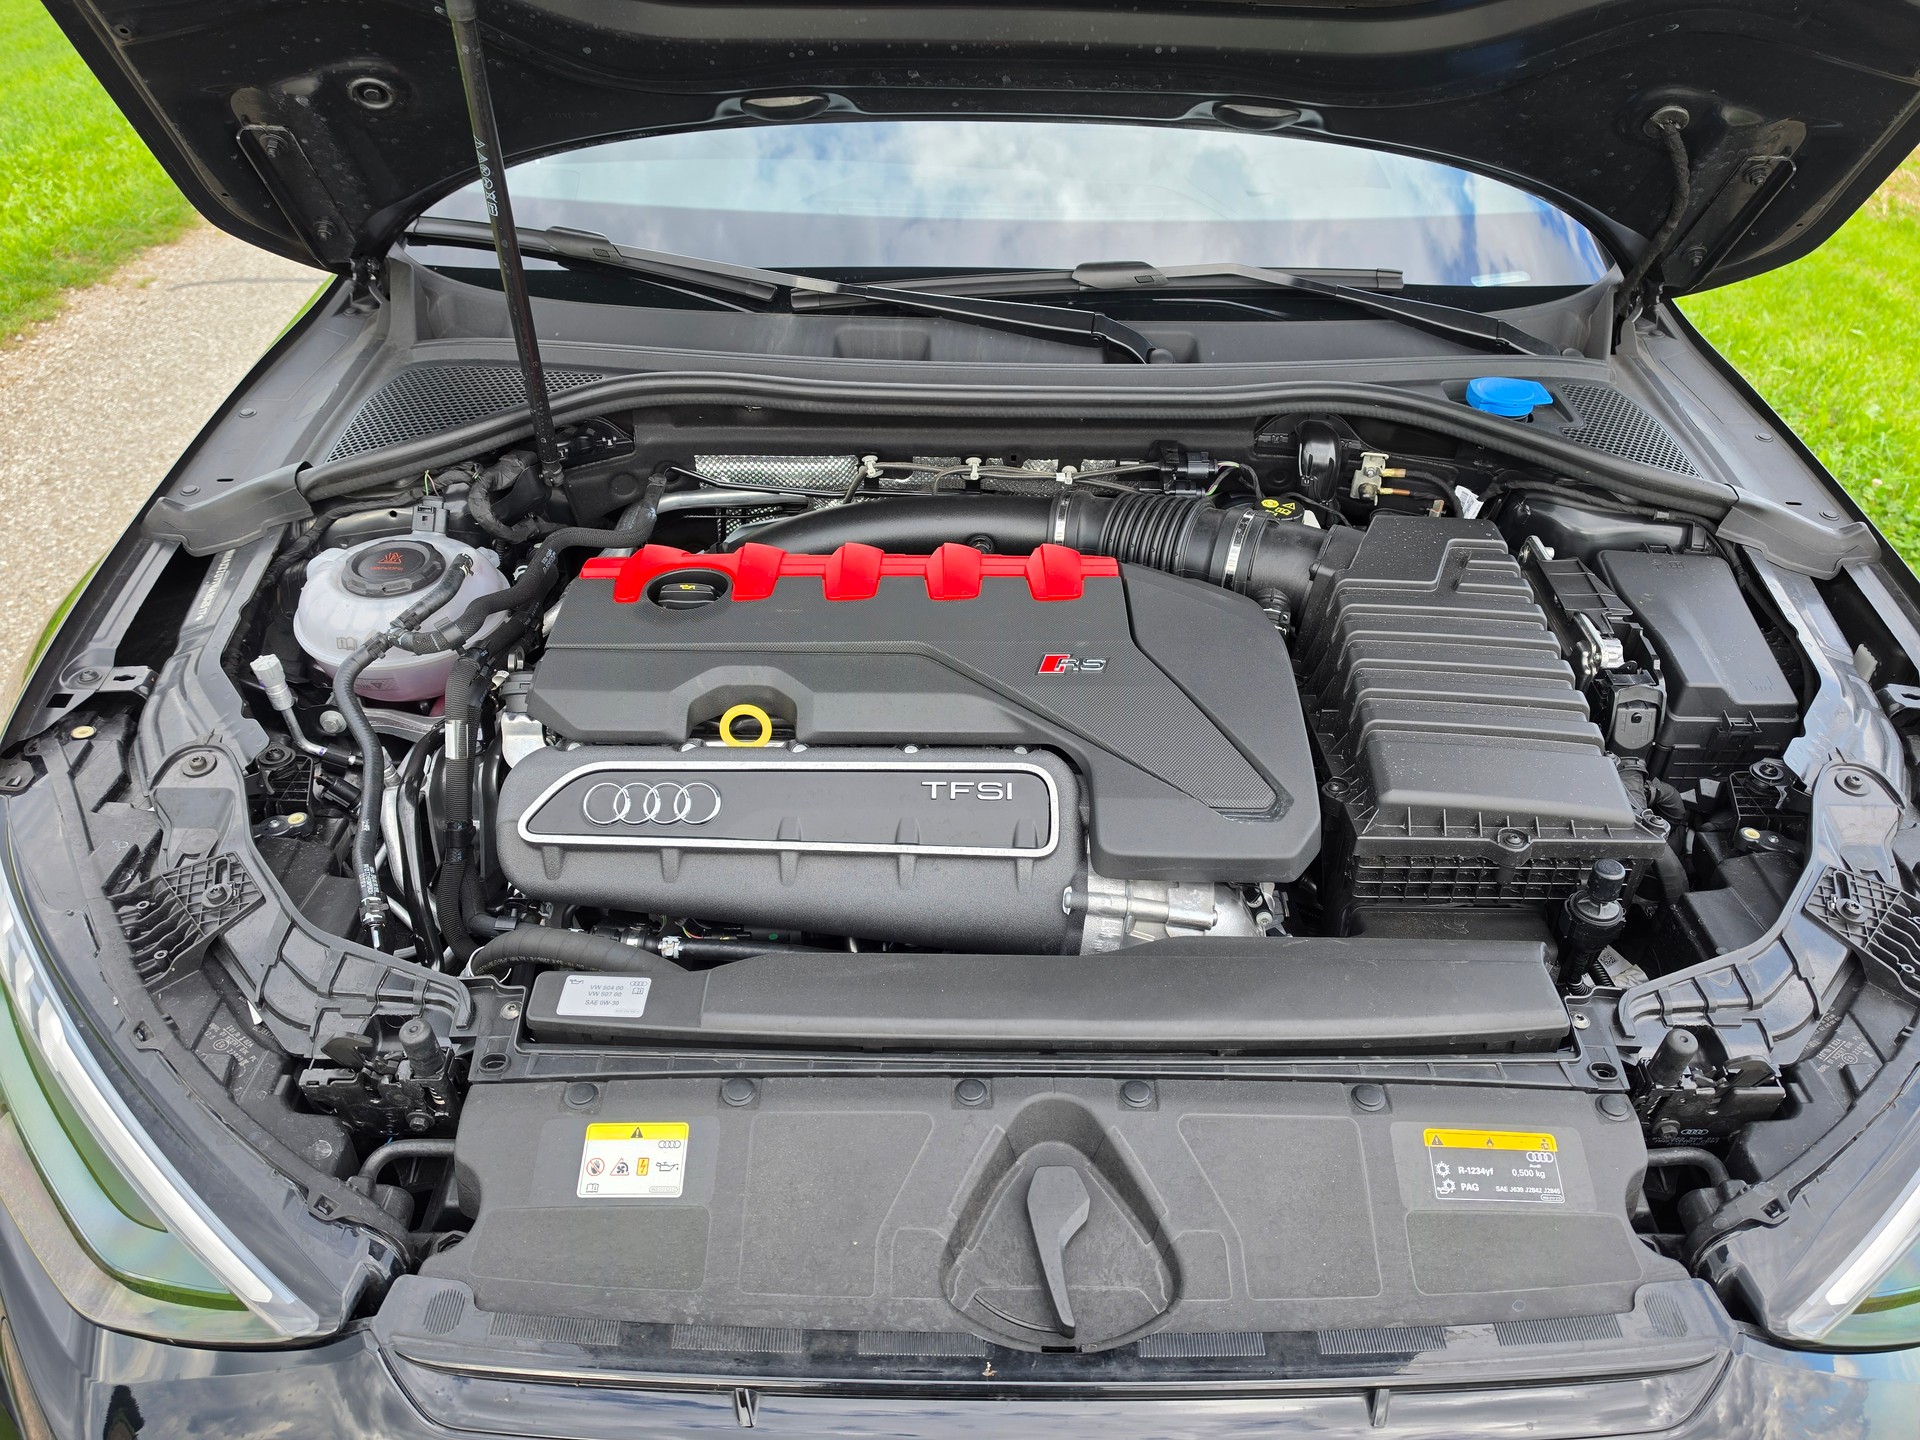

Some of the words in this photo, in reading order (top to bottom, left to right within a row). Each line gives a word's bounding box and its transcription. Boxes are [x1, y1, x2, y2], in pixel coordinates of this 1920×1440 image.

[1045, 654, 1106, 673] RS
[921, 781, 1013, 801] TFSI
[1458, 1166, 1494, 1176] R-1234yf
[1511, 1168, 1534, 1177] 0,500
[1535, 1169, 1546, 1179] kg
[1460, 1182, 1480, 1192] PAG
